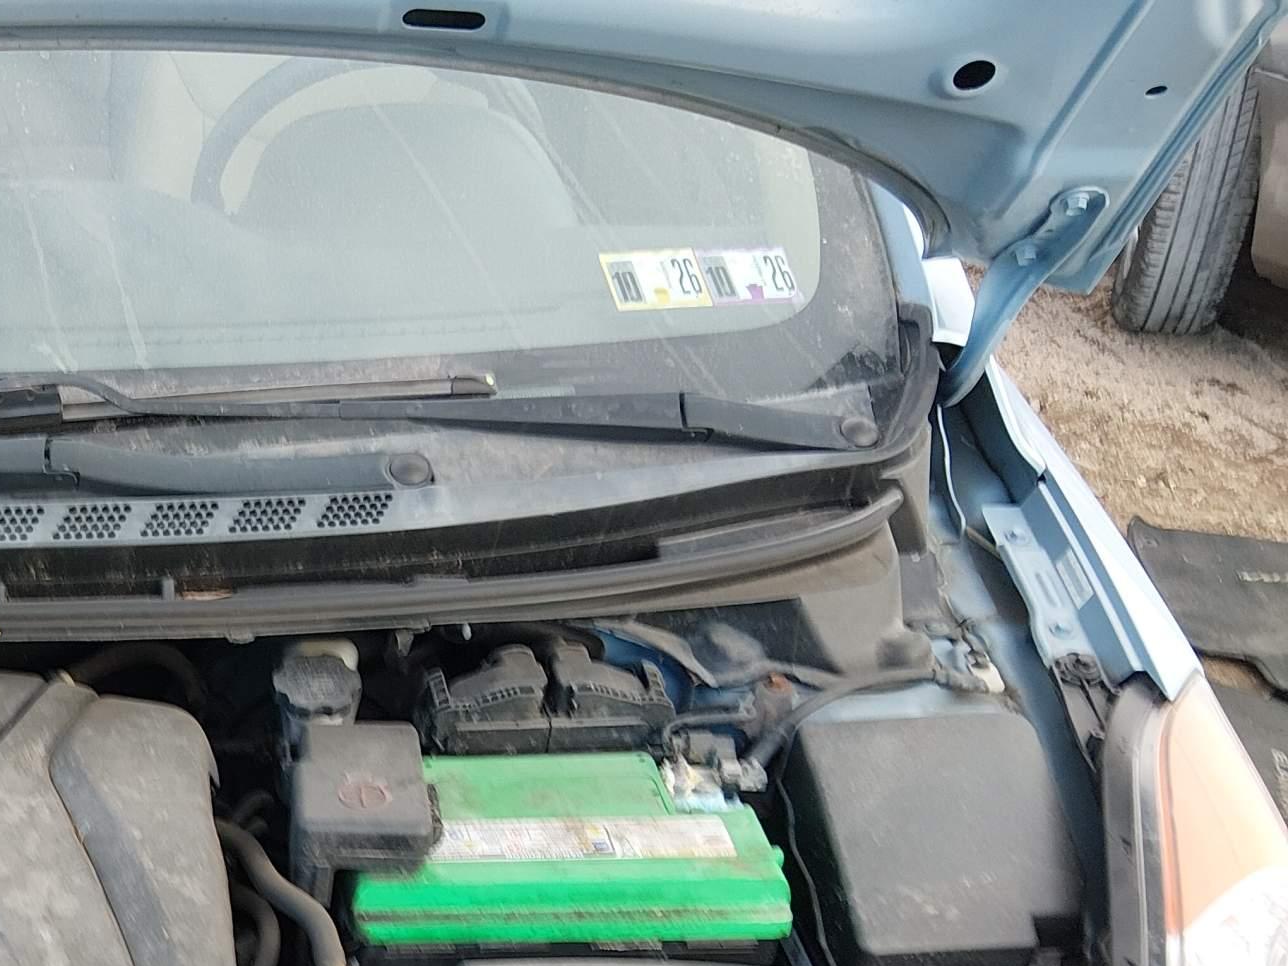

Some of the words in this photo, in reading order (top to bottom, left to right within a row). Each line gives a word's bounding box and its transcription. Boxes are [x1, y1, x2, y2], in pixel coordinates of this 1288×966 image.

[611, 271, 643, 303] 10
[670, 258, 703, 298] 26
[705, 266, 737, 297] 10
[763, 256, 795, 291] 26
